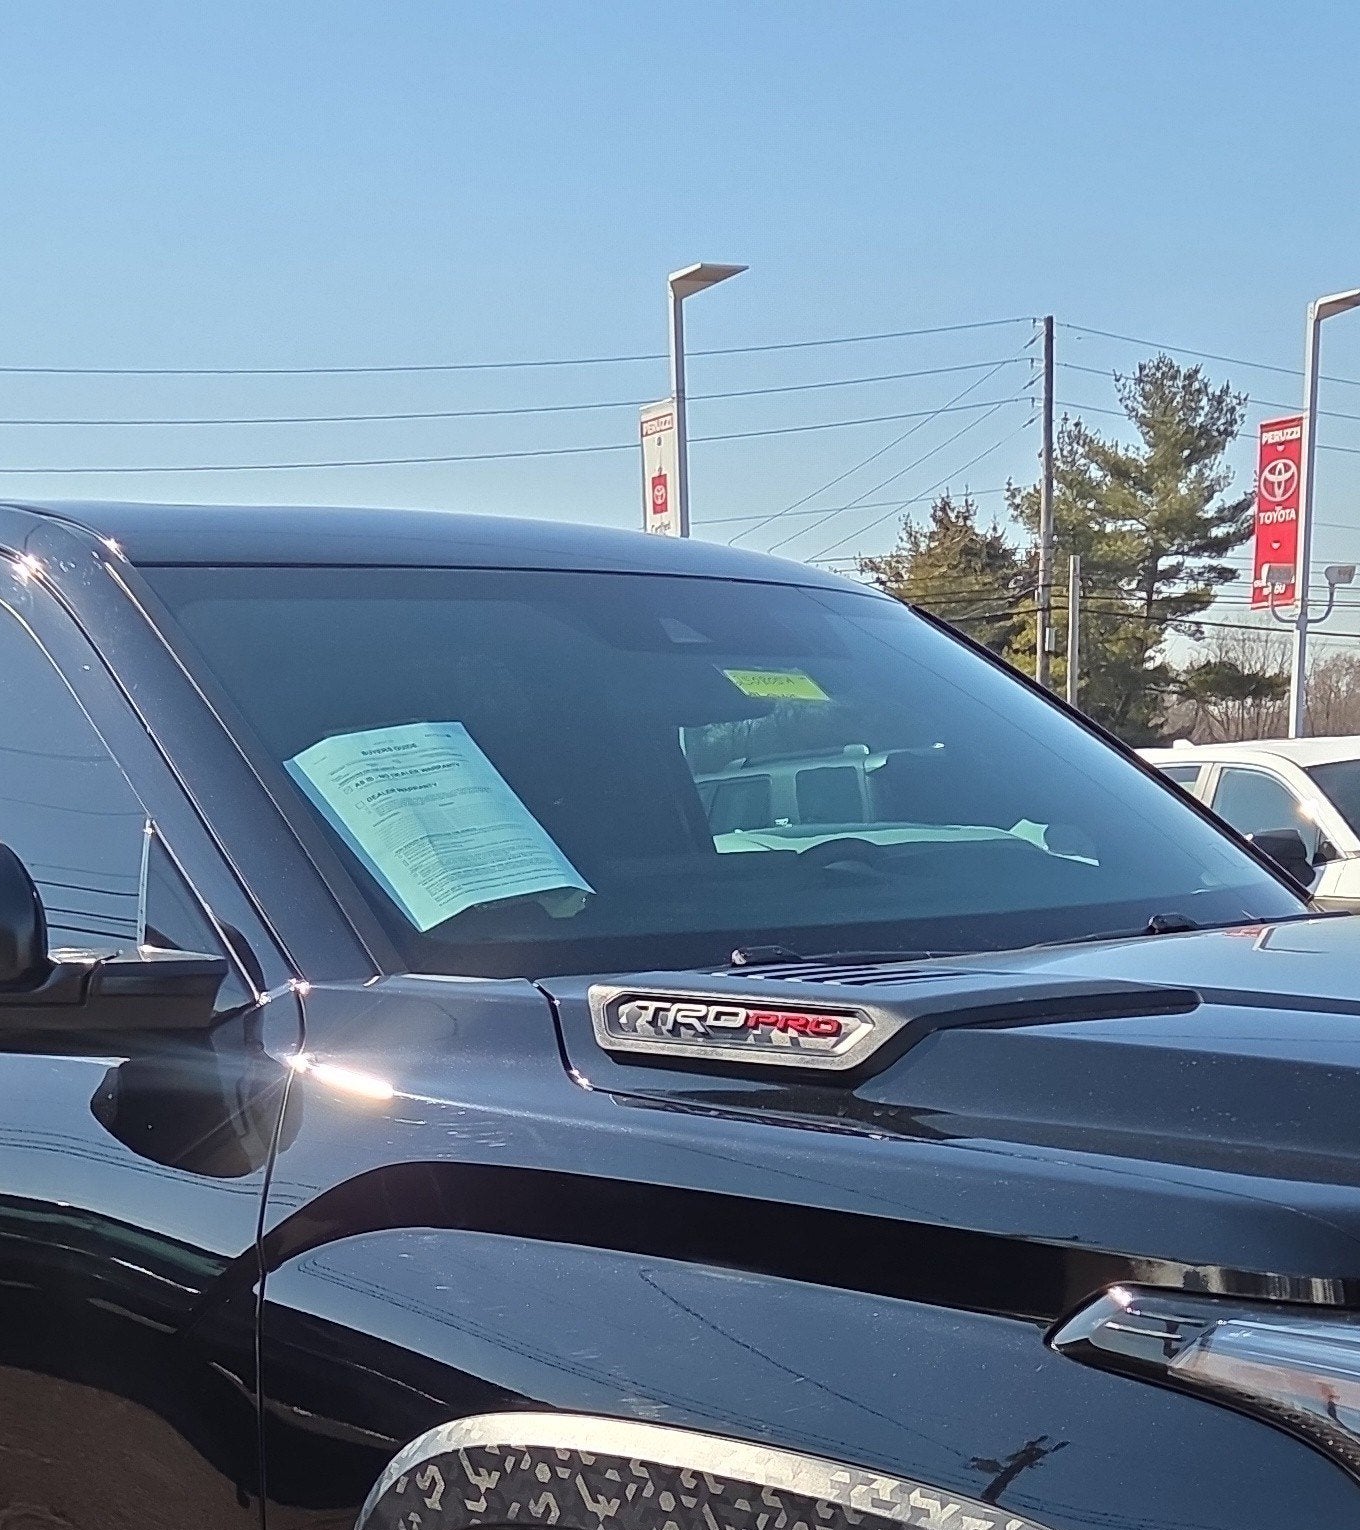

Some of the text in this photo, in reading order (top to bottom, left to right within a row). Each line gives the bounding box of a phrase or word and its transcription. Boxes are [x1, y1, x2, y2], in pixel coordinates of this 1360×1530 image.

[1262, 427, 1300, 445] PERUZZI
[1259, 508, 1296, 525] TOYOTA
[636, 1000, 843, 1037] TRD PRO
